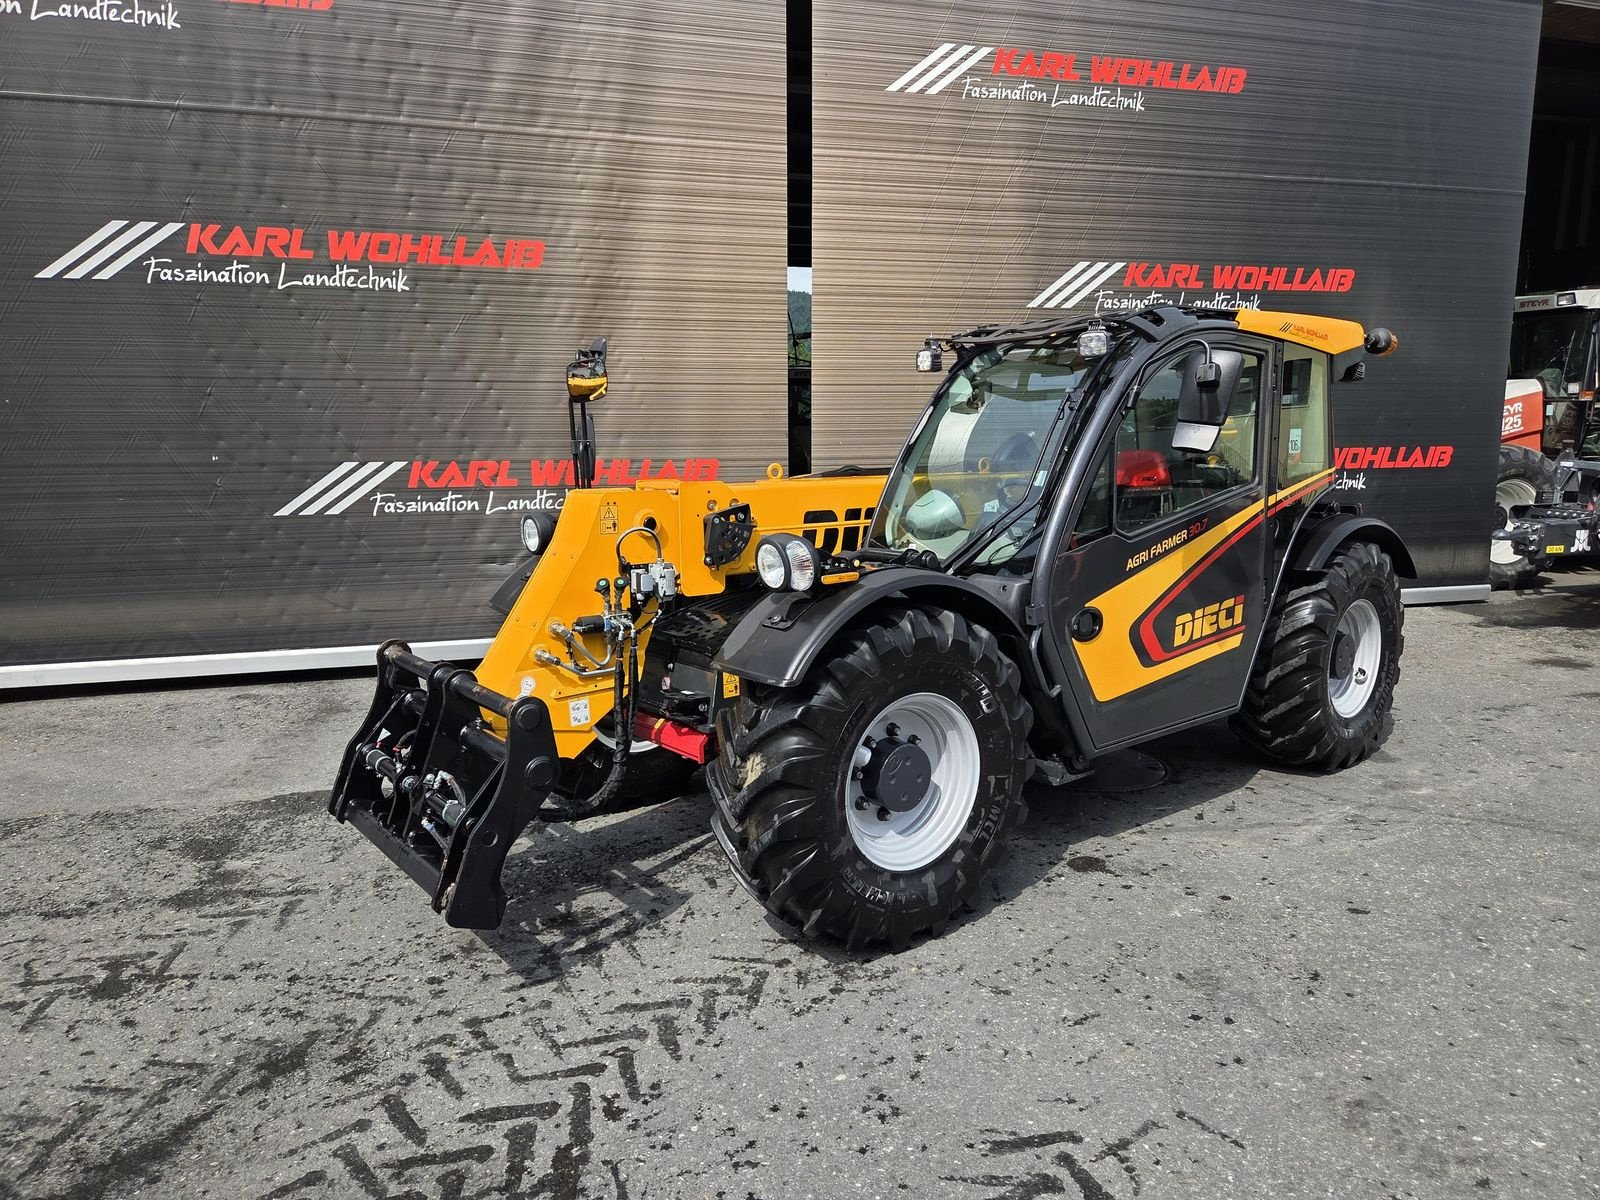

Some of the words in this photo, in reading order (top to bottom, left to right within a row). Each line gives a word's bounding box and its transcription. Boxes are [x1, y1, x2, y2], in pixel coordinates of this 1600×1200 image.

[30, 0, 182, 30] Landtechnik
[992, 48, 1080, 81] KARL
[961, 76, 1047, 103] Faszination
[1051, 83, 1145, 112] Landtechnik
[186, 223, 314, 260] KARL
[143, 256, 270, 285] Faszination
[278, 262, 410, 292] Landtechnik
[1123, 262, 1203, 289] KARL
[1519, 299, 1550, 309] STEYR
[1503, 402, 1523, 415] EYR
[408, 459, 519, 489] KARL
[370, 491, 479, 516] Faszination
[485, 489, 568, 515] Landtec
[1126, 548, 1149, 572] AGRI
[1149, 530, 1188, 559] FARMER
[1188, 517, 1209, 540] 30.7
[1174, 594, 1245, 648] DIECI
